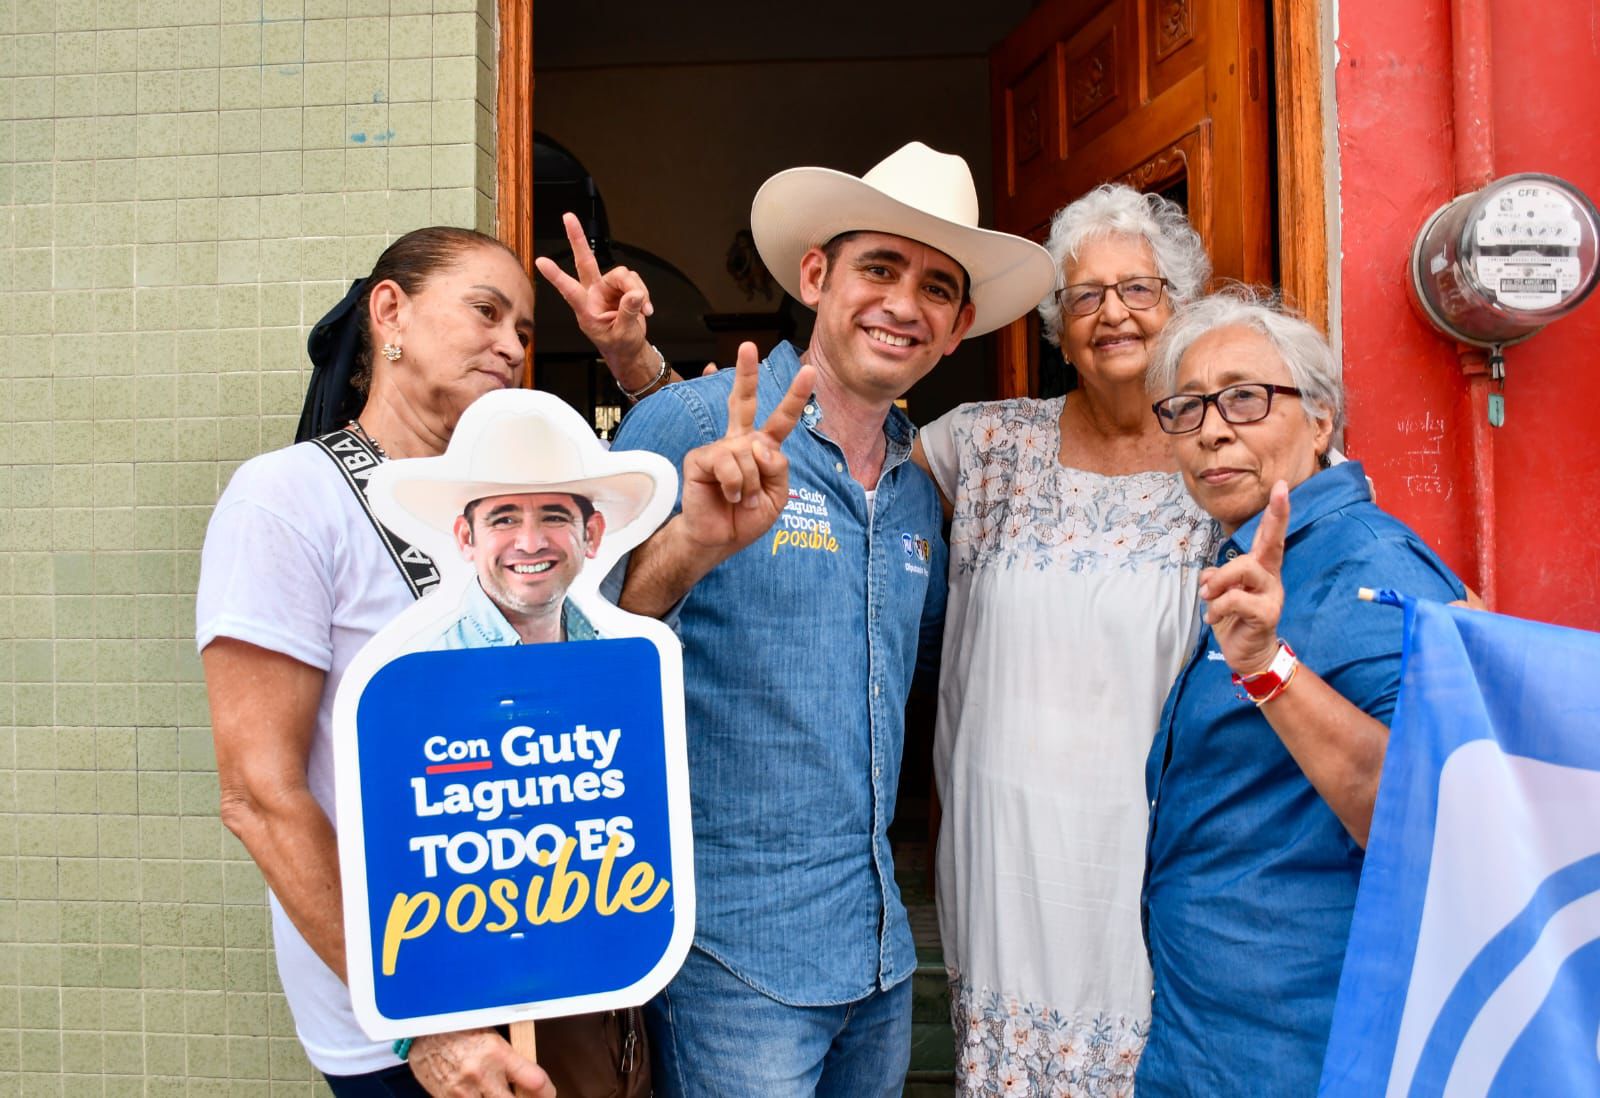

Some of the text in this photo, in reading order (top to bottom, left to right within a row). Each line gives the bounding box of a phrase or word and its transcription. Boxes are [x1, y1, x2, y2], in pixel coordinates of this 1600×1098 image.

[1518, 188, 1539, 198] CFE
[799, 487, 826, 507] Guty
[772, 525, 839, 556] posible
[781, 513, 816, 531] TODO
[424, 724, 621, 769] Con Guty
[410, 769, 626, 821] Lagunes
[409, 816, 635, 878] TODO ES
[382, 833, 671, 976] posible
